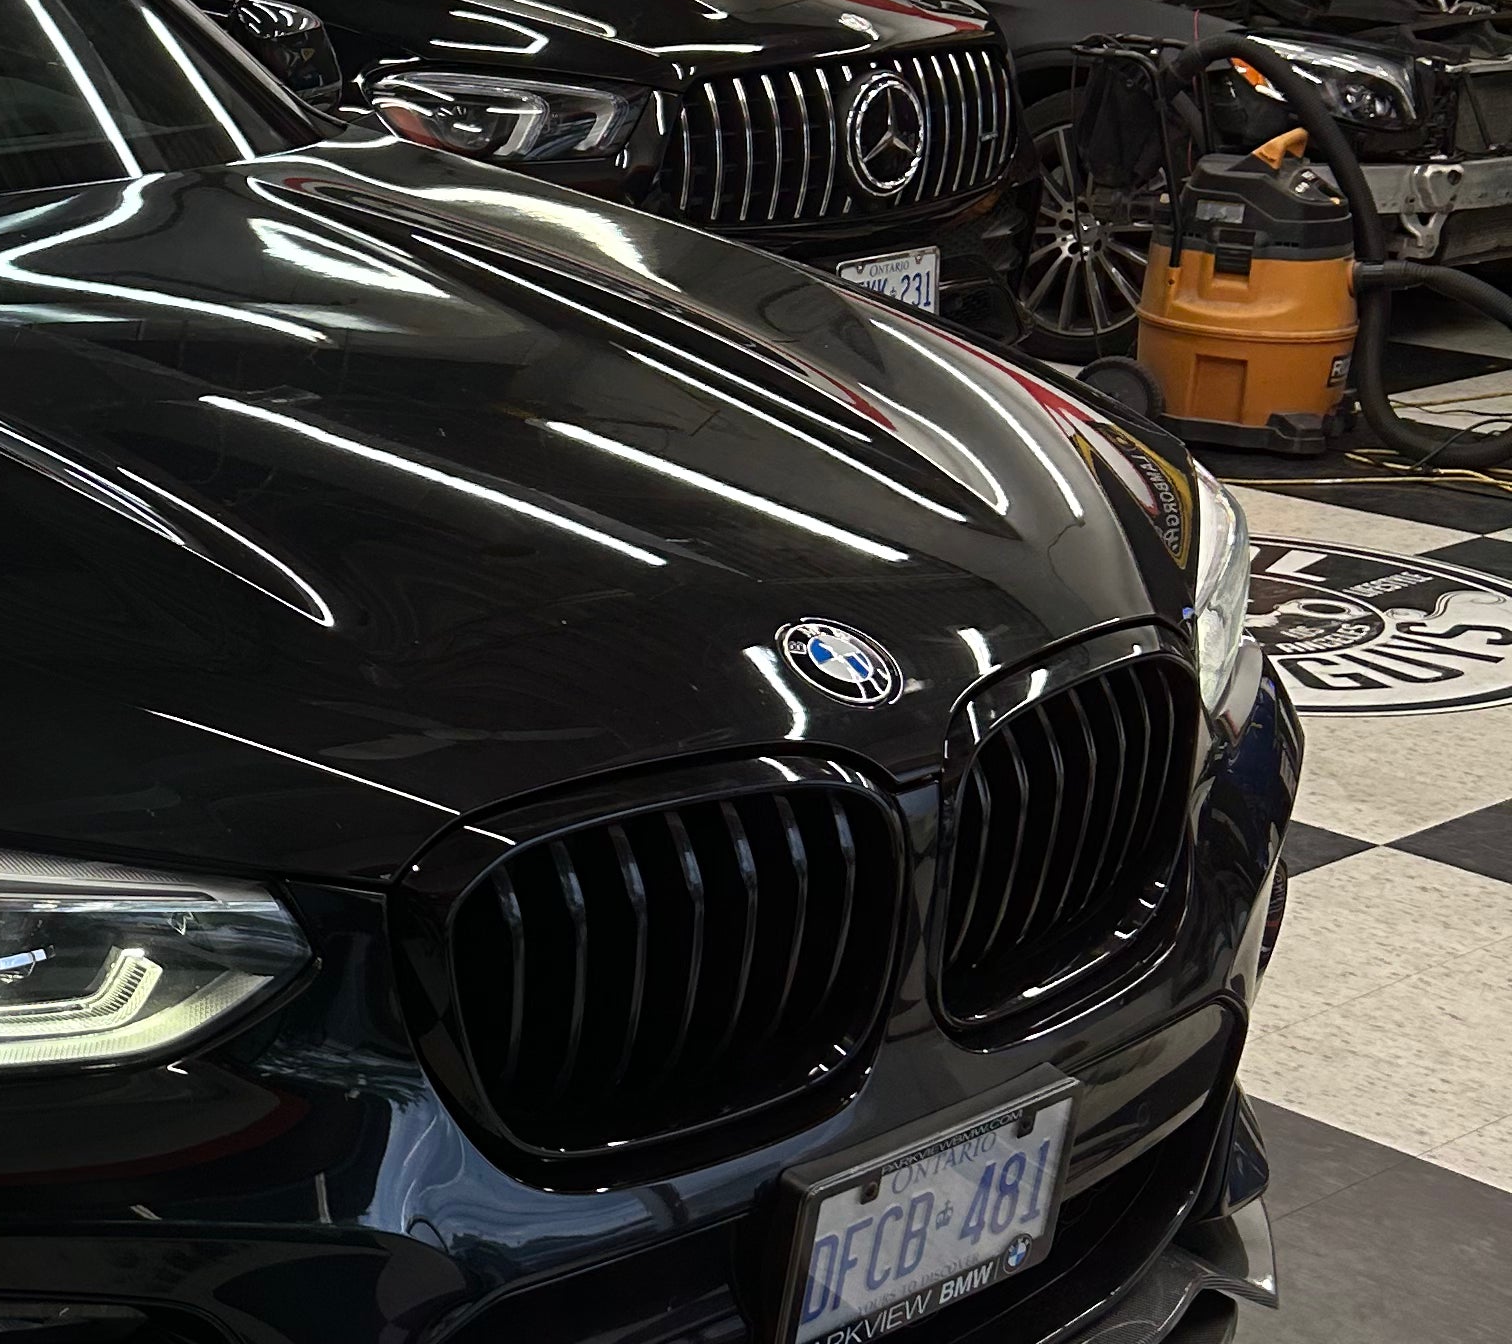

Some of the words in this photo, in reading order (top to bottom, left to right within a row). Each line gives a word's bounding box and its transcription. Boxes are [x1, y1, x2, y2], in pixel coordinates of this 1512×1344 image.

[869, 261, 909, 277] ONTARIO
[901, 271, 931, 307] 231
[1277, 621, 1512, 691] GUYS
[881, 1109, 1024, 1176] PARKVIEWBMW.COM
[891, 1131, 998, 1195] ONTARIO
[800, 1191, 936, 1325] DFCB
[959, 1137, 1051, 1246] 481
[938, 1261, 994, 1306] BMW
